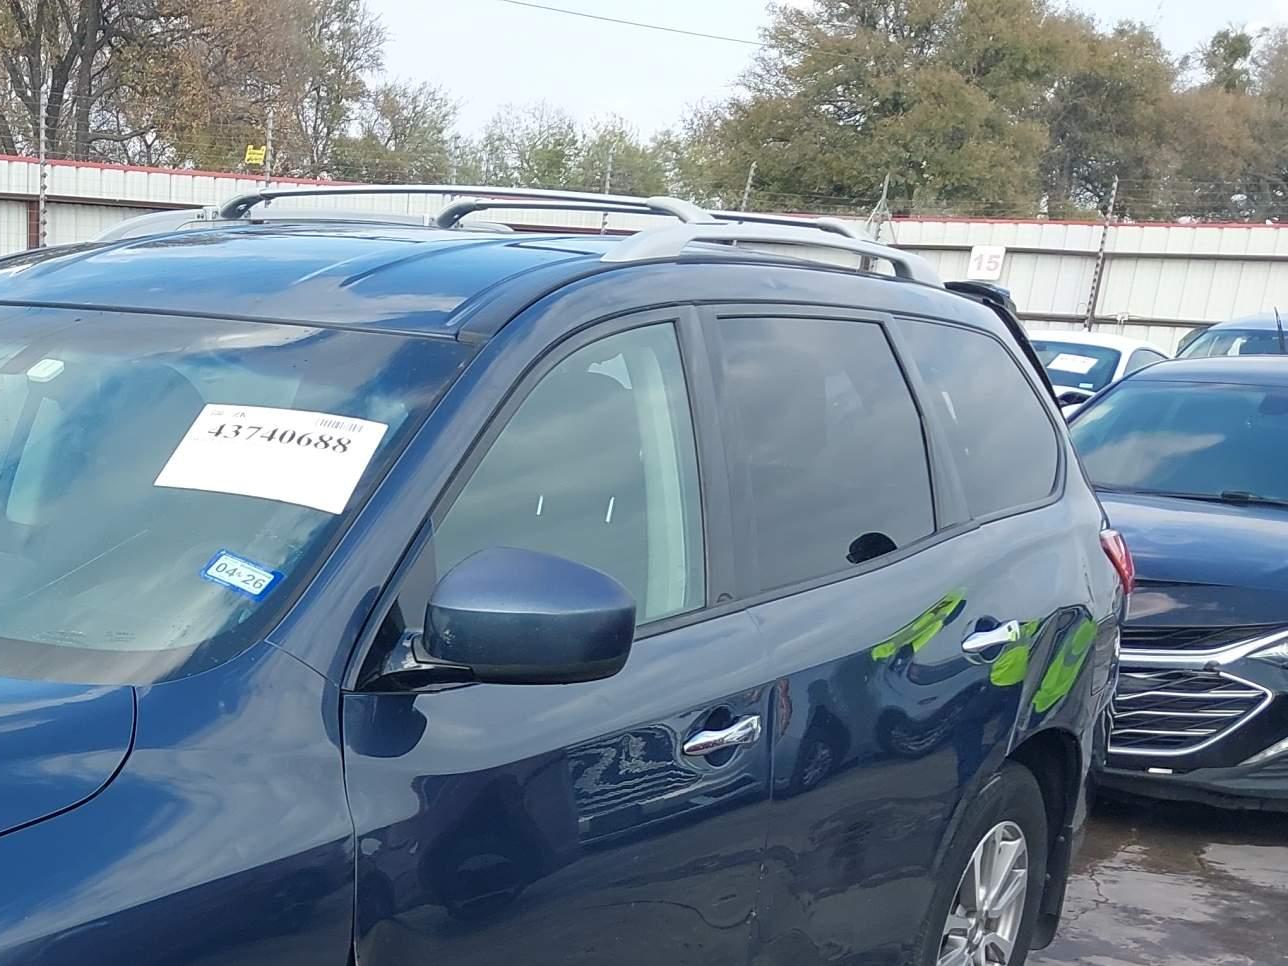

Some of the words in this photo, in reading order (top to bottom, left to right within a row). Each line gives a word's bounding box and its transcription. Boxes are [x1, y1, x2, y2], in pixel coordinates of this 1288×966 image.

[972, 253, 1001, 272] 15
[207, 423, 352, 454] 43740688
[215, 562, 239, 578] 04
[240, 574, 266, 589] 26
